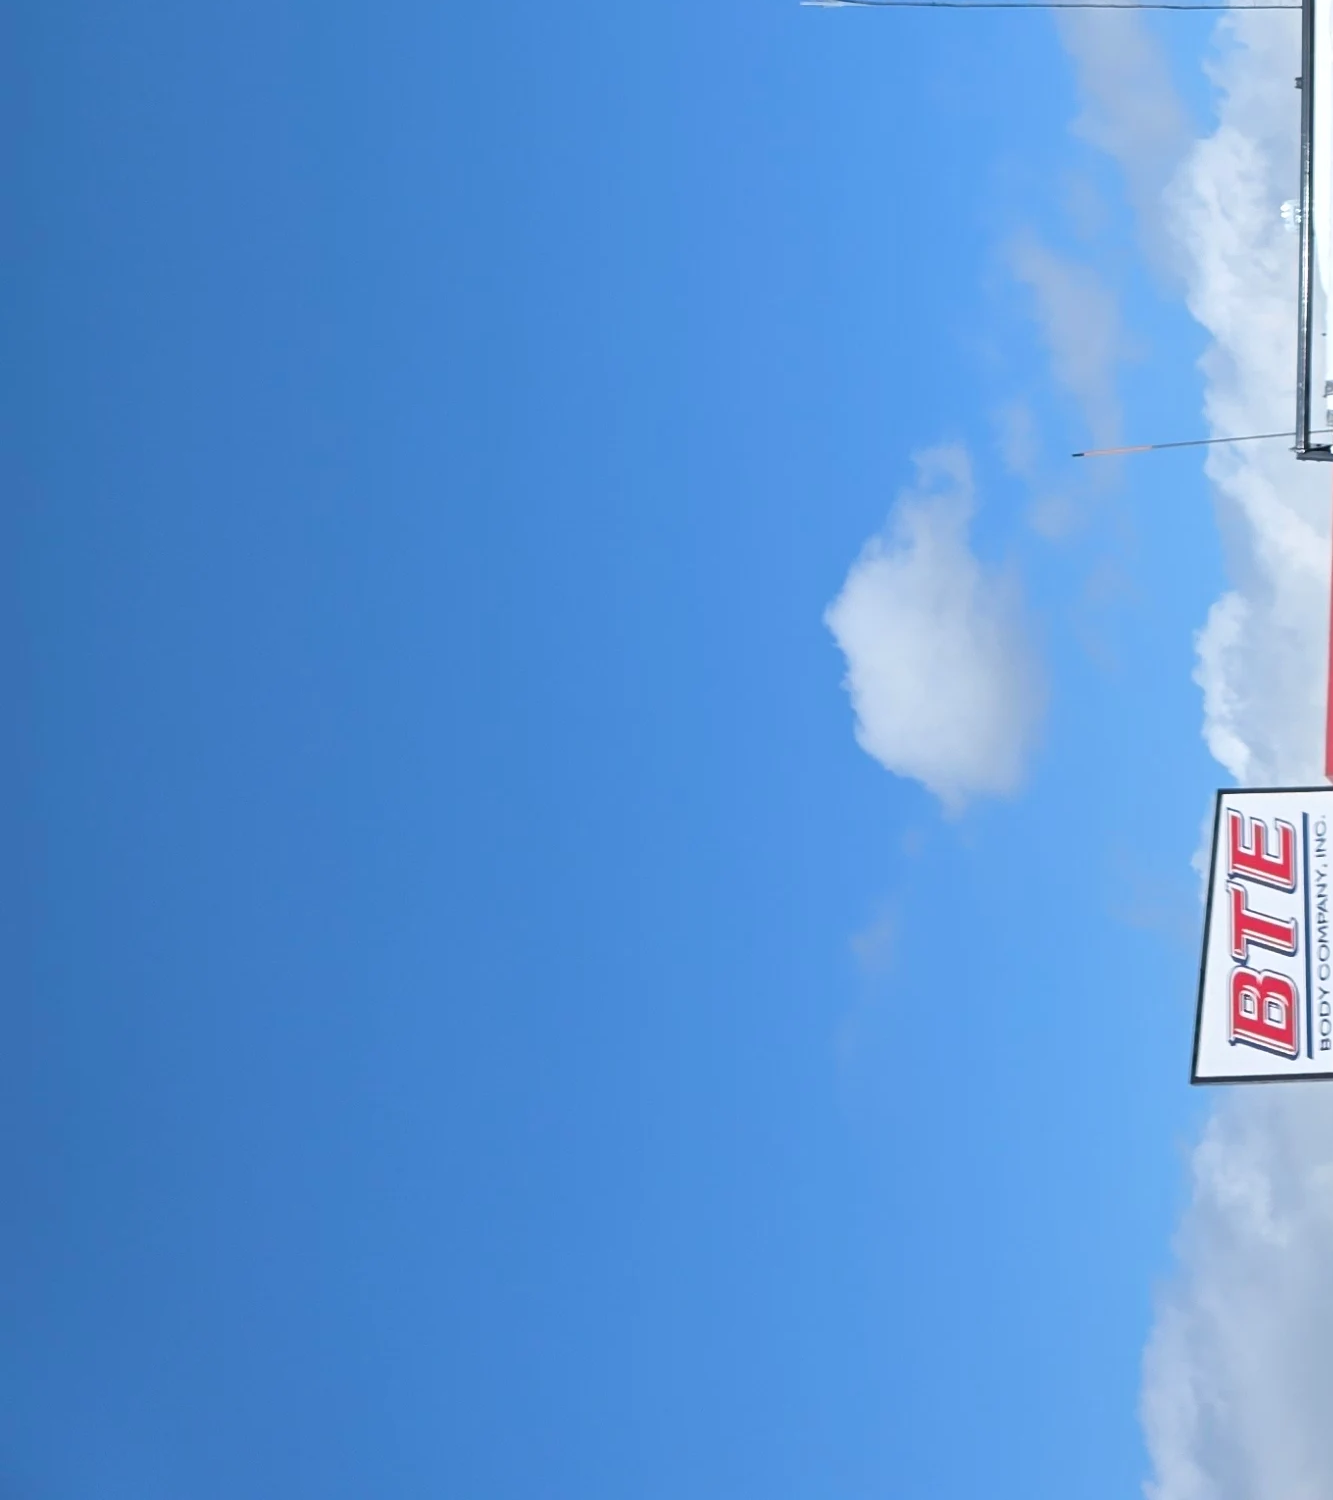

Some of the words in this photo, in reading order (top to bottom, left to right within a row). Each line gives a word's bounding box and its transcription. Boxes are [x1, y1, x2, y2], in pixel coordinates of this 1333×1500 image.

[1314, 815, 1327, 858] INC.
[1225, 807, 1299, 1061] BTE
[1315, 864, 1331, 981] COMPANY,
[1317, 987, 1332, 1051] BODY
